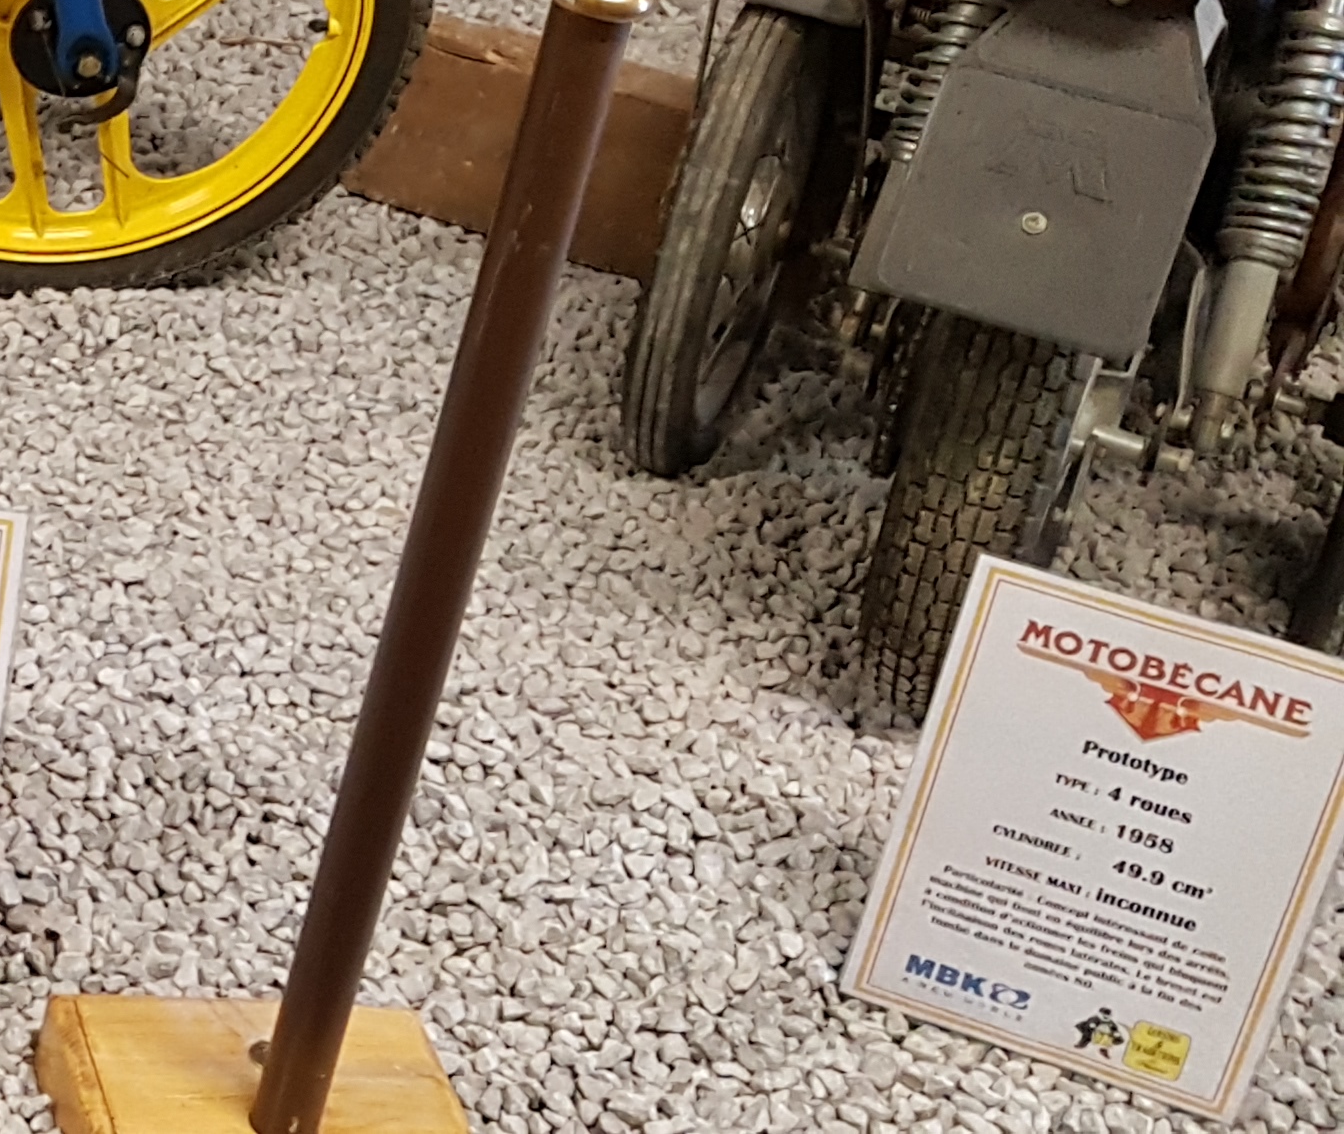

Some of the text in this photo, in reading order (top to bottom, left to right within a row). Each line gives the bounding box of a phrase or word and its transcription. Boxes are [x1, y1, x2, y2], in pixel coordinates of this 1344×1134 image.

[1020, 619, 1313, 726] MOTOBÉCANE
[1082, 740, 1189, 785] Prototype
[1055, 773, 1091, 793] TYPE
[1108, 786, 1122, 802] 4
[1129, 795, 1193, 825] roues
[1116, 824, 1174, 854] 1958
[985, 856, 1043, 882] VITESSE
[1046, 876, 1082, 896] MAXI
[1095, 887, 1197, 933] inconnue
[1112, 860, 1165, 886] 49.9
[905, 954, 987, 997] MBK
